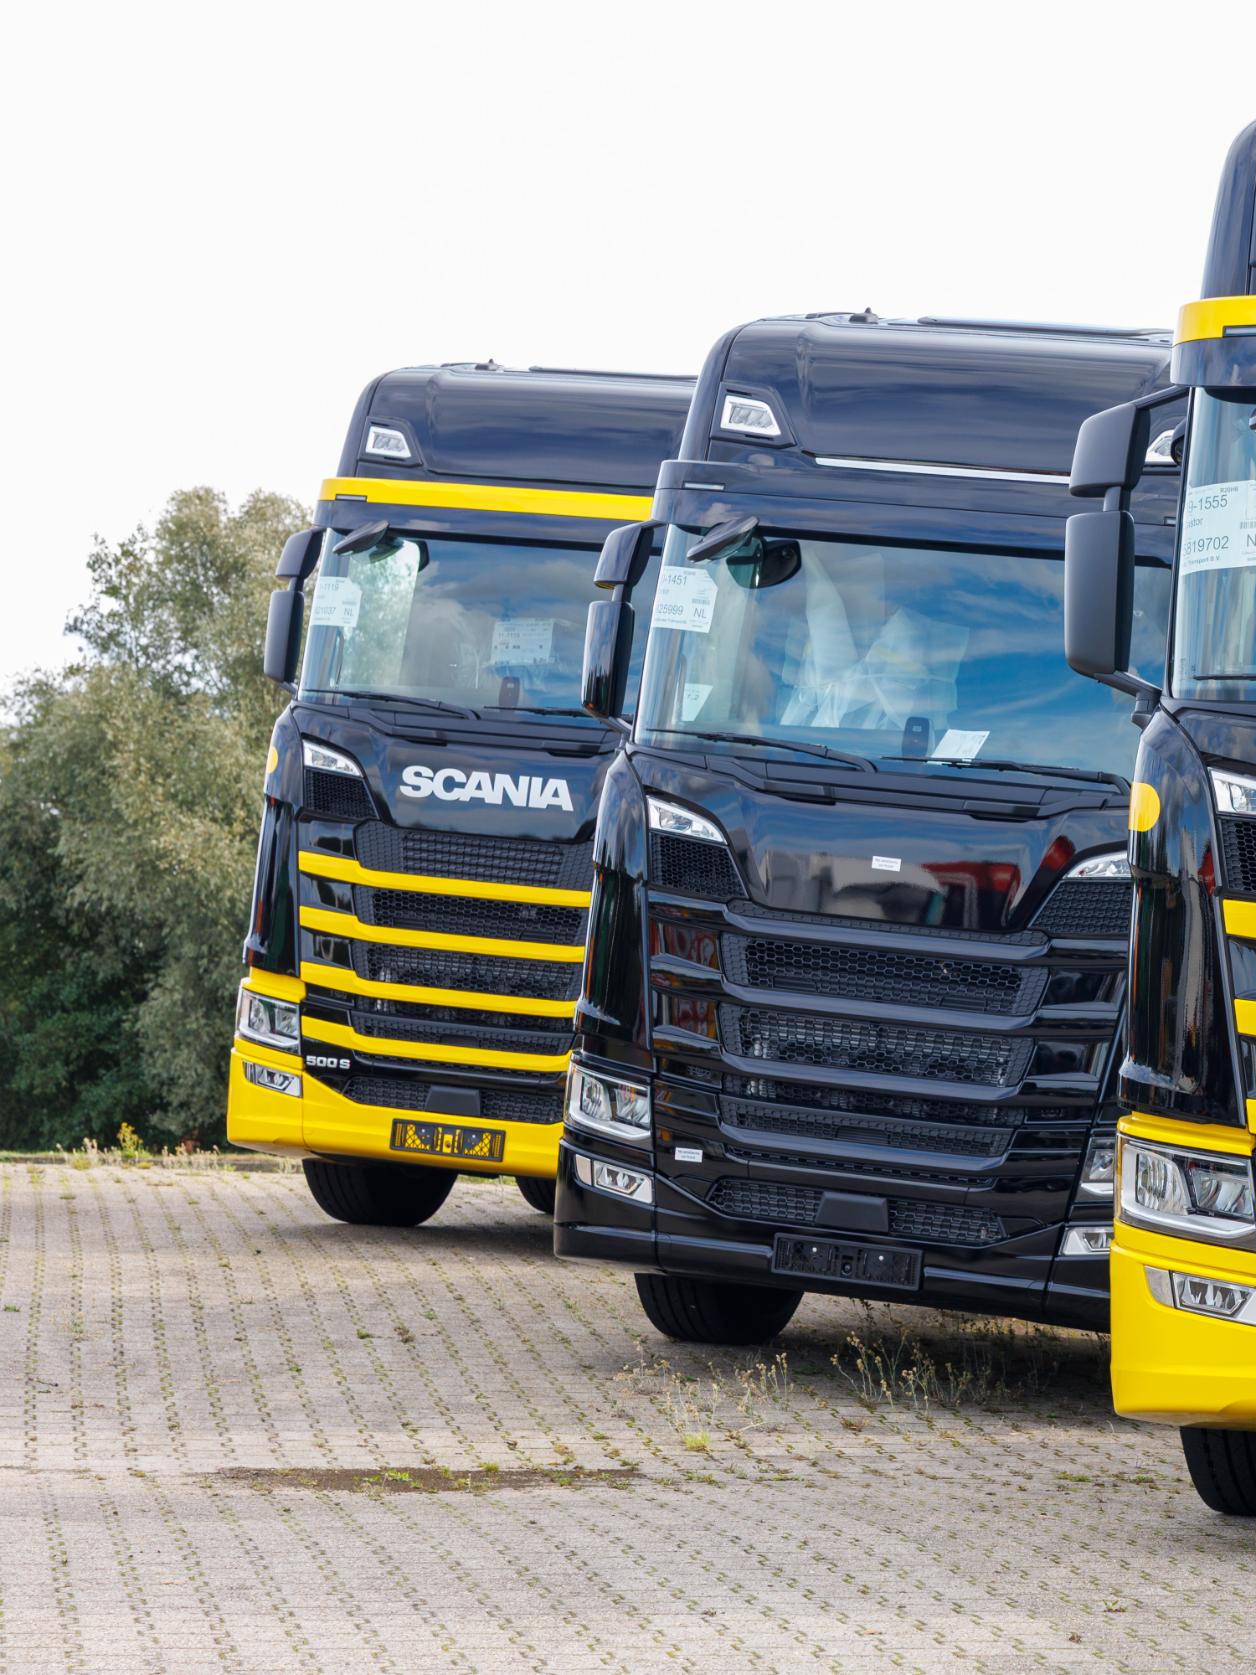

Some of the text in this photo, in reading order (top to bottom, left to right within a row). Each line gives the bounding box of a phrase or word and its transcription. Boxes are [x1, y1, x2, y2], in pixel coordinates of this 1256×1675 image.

[343, 607, 355, 617] NL
[693, 607, 708, 619] NL
[399, 765, 574, 812] SCANIA
[306, 1055, 351, 1070] 500 S
